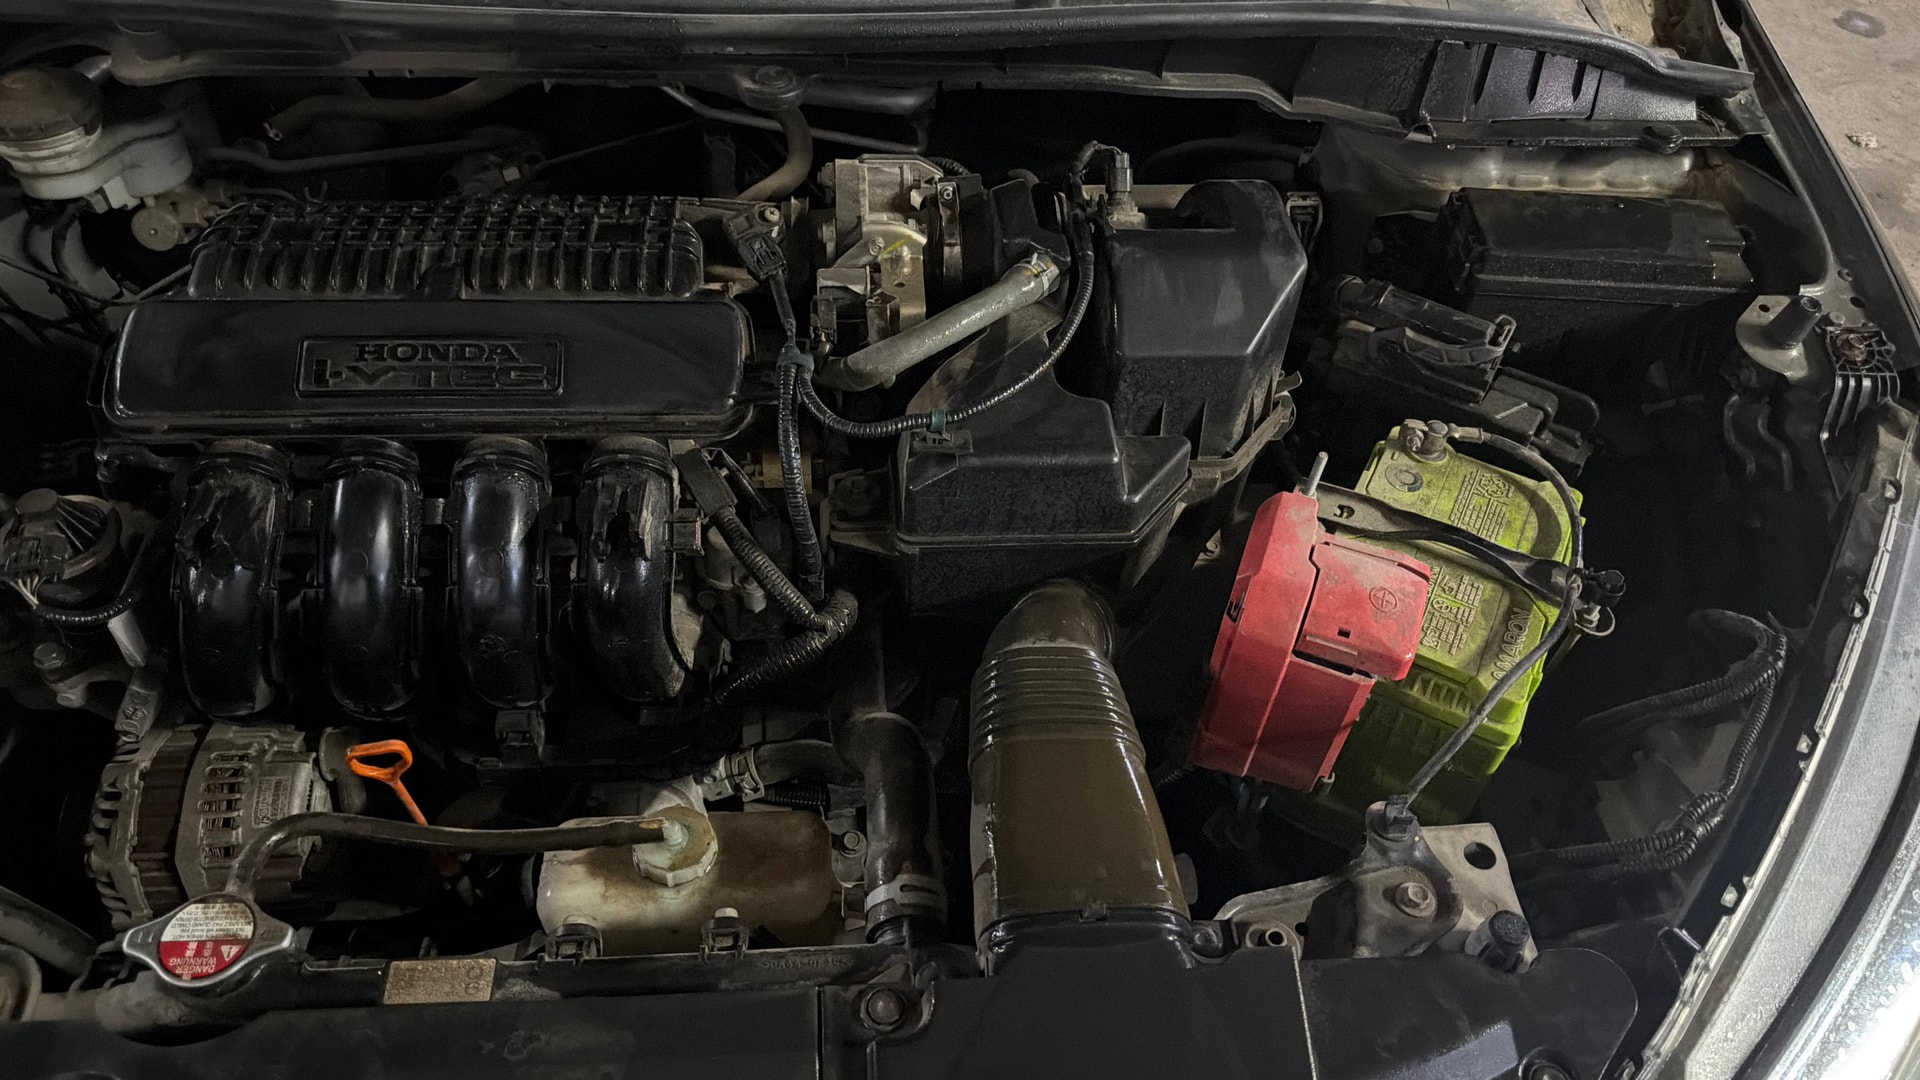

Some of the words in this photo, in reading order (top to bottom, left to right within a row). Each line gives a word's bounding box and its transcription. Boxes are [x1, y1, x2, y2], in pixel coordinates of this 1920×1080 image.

[355, 343, 522, 362] HONDA
[1491, 607, 1532, 681] AMARON
[169, 957, 217, 966] WARNUNG
[175, 965, 215, 974] DANGER
